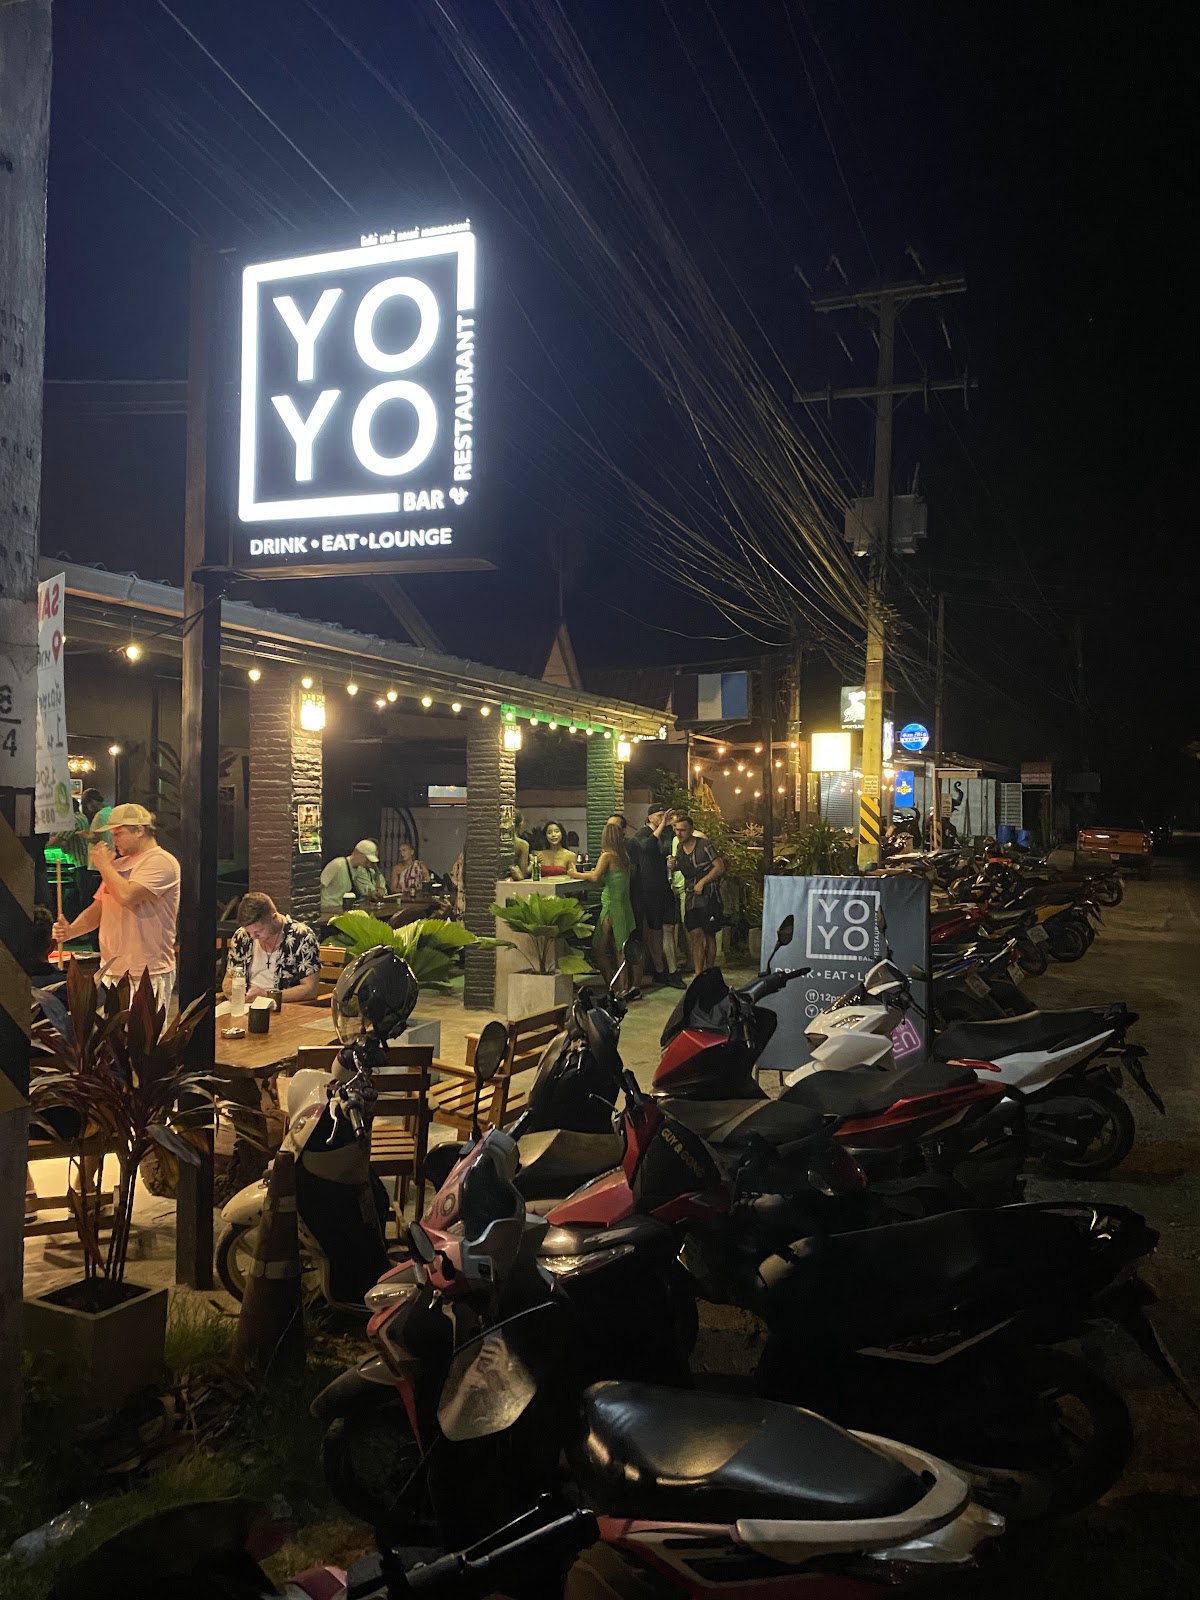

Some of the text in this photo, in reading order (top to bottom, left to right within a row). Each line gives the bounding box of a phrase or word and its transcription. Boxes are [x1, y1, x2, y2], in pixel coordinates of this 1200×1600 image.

[272, 276, 440, 381] YO
[453, 315, 476, 482] RESTAURANT
[270, 380, 438, 482] YO
[403, 489, 445, 512] BAR
[250, 528, 453, 556] DRINK EAT LOUNGE
[3, 729, 17, 757] 4
[818, 899, 870, 924] YO
[817, 925, 870, 952] YO
[824, 970, 848, 981] EAT
[661, 1127, 679, 1146] GUY
